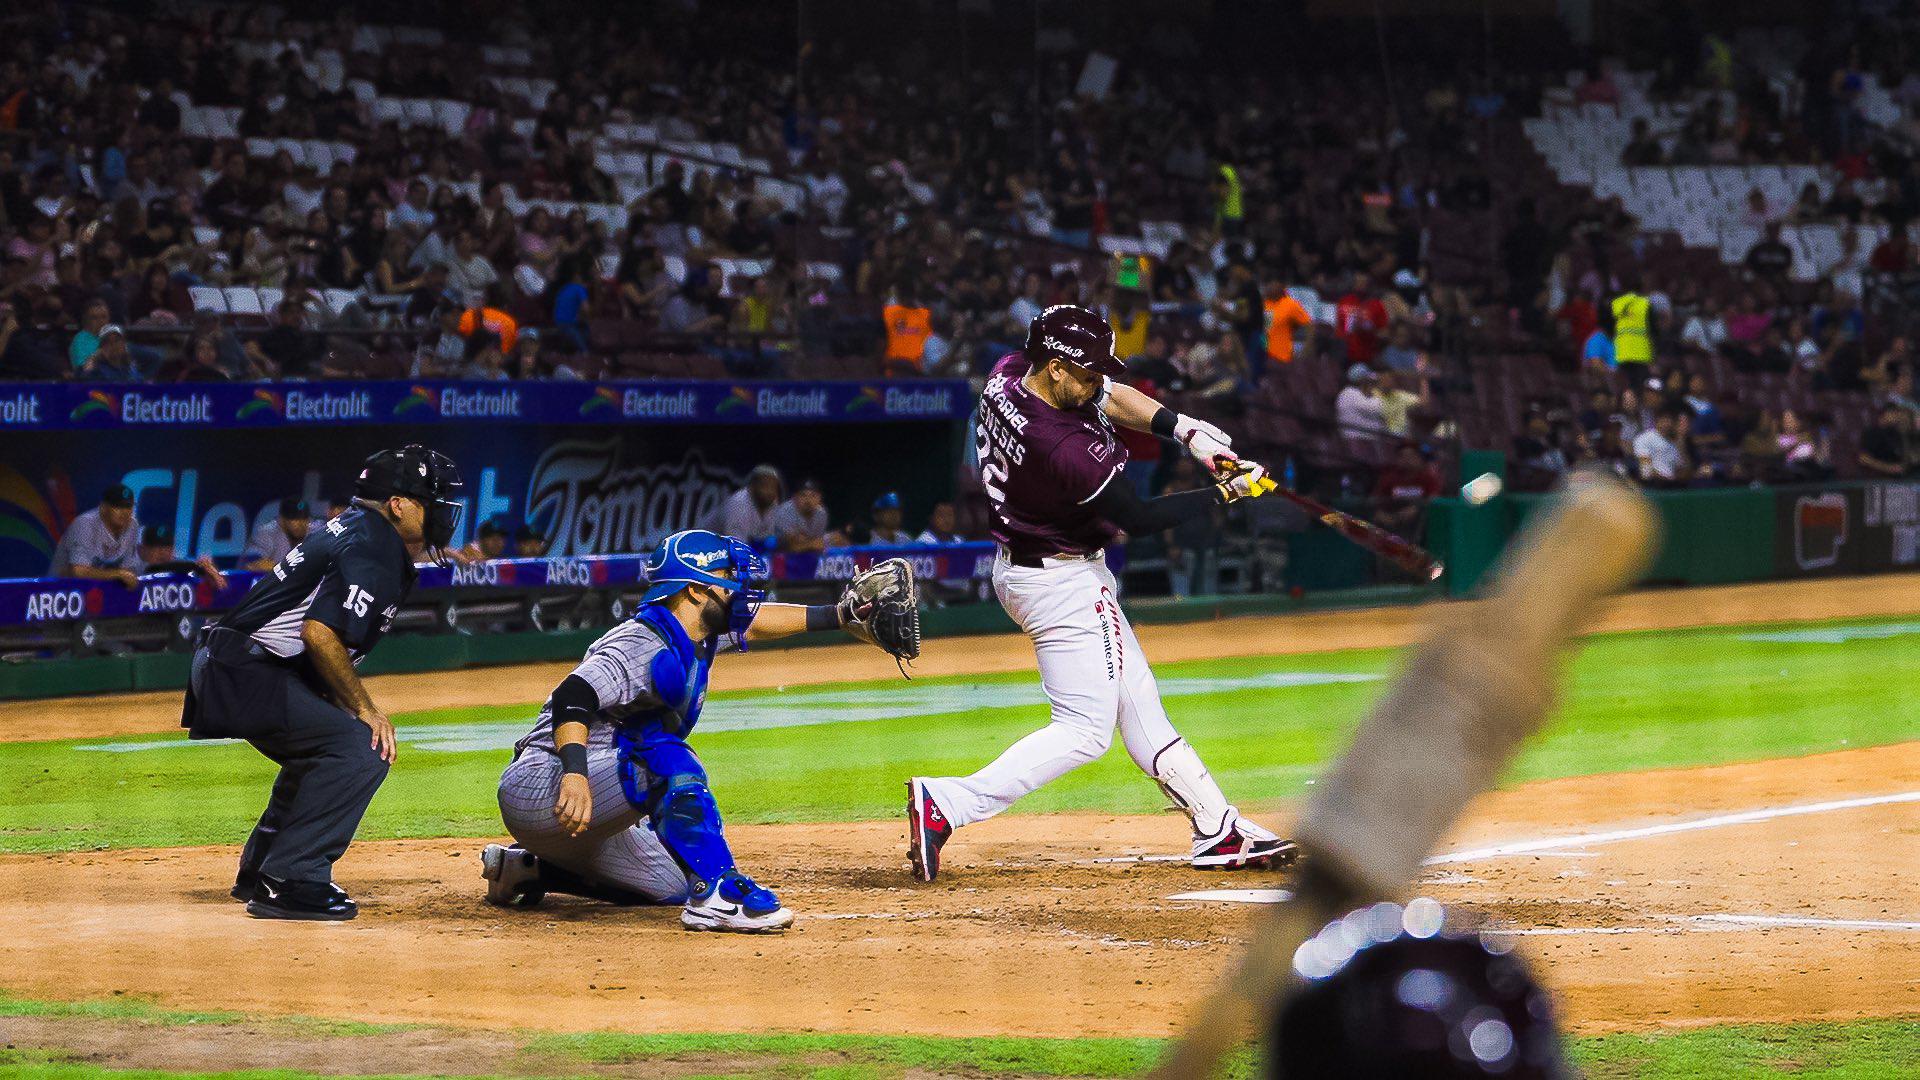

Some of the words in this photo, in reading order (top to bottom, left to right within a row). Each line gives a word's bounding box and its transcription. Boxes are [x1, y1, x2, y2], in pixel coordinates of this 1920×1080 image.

[122, 392, 212, 423] Electrolit
[285, 391, 371, 420] Electrolit
[440, 389, 520, 417] Electrolit
[622, 388, 697, 417] Electrolit
[756, 388, 827, 416] Electrolit
[884, 387, 952, 414] Electrolit
[978, 398, 1026, 466] ENESES
[546, 560, 590, 585] ARCO
[815, 556, 854, 579] ARCO
[26, 591, 83, 621] ARCO
[138, 584, 193, 612] ARCO
[342, 584, 375, 618] 15
[1100, 614, 1115, 681] caliente.mx
